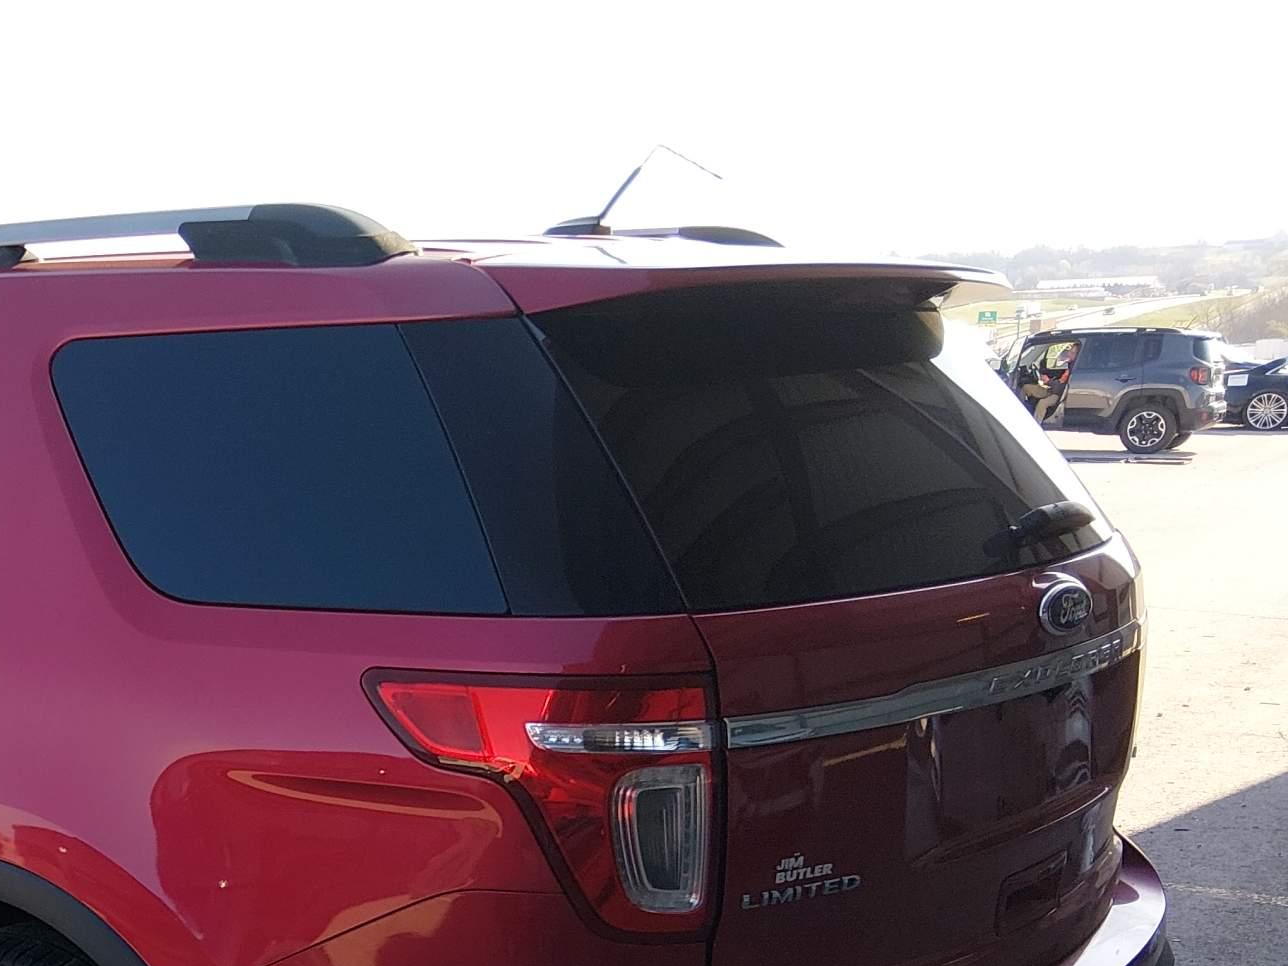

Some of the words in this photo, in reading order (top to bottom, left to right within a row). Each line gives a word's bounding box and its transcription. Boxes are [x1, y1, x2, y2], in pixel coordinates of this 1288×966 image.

[1060, 592, 1089, 625] Ford
[987, 638, 1123, 694] EXPLORER
[775, 863, 833, 884] BUTLER
[776, 855, 805, 872] JIM
[741, 875, 862, 910] LIMITED
